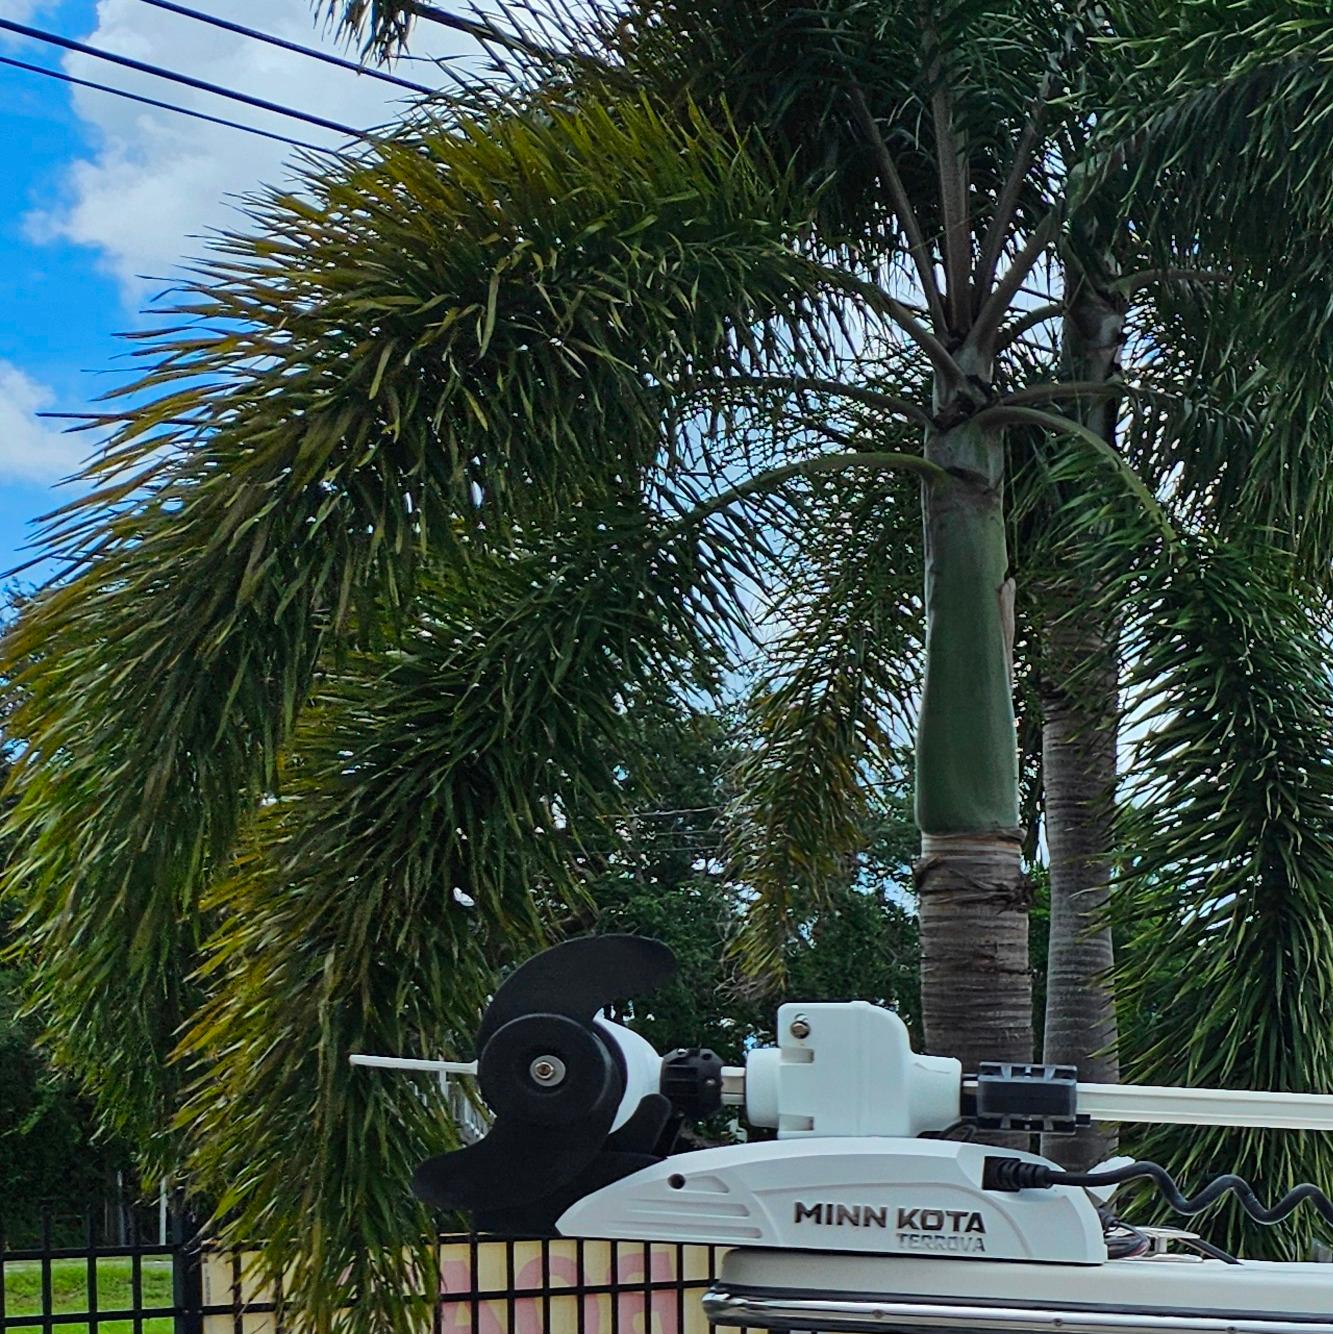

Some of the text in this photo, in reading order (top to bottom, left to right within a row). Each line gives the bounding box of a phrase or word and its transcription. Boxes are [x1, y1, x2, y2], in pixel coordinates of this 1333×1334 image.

[795, 1201, 986, 1234] MINN KOTA
[897, 1233, 986, 1253] TERROVA
